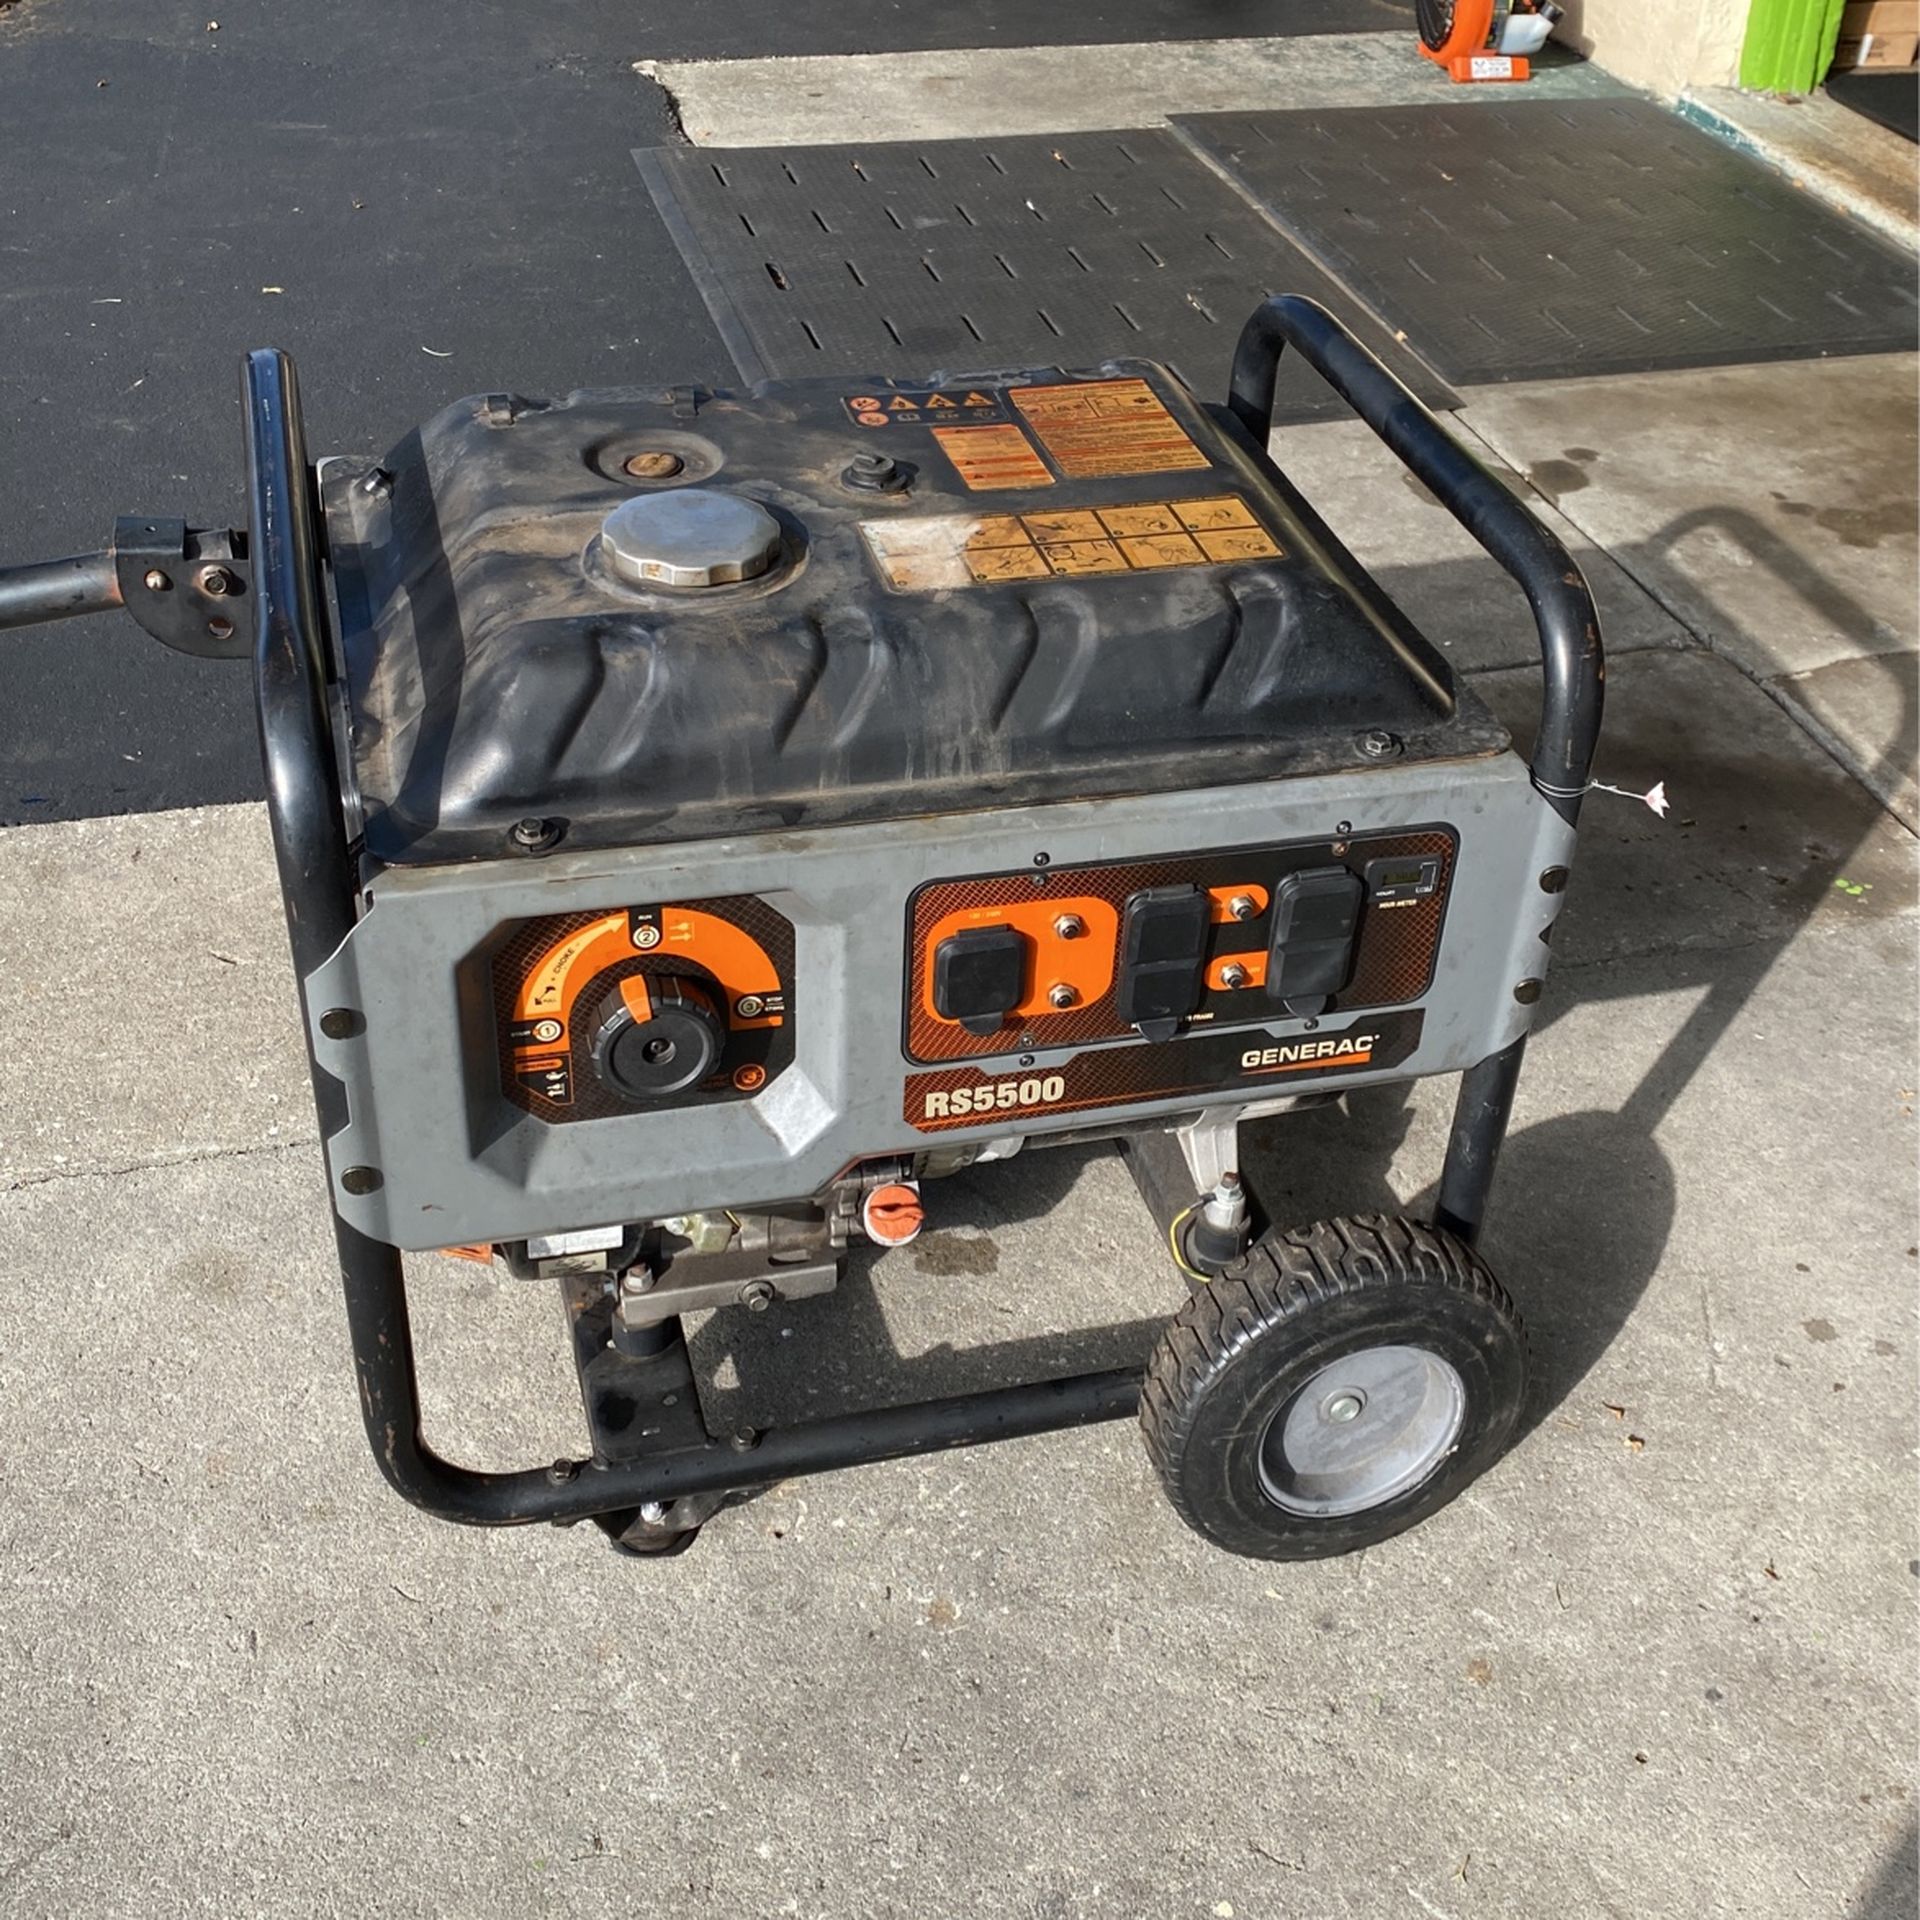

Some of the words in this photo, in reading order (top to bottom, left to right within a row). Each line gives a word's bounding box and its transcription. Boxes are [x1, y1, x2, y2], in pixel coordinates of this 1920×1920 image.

[1397, 899, 1417, 907] METER
[642, 932, 651, 942] 2
[553, 947, 575, 974] CHOKE
[1241, 1034, 1374, 1068] GENERAC
[925, 1076, 1064, 1118] RS5500
